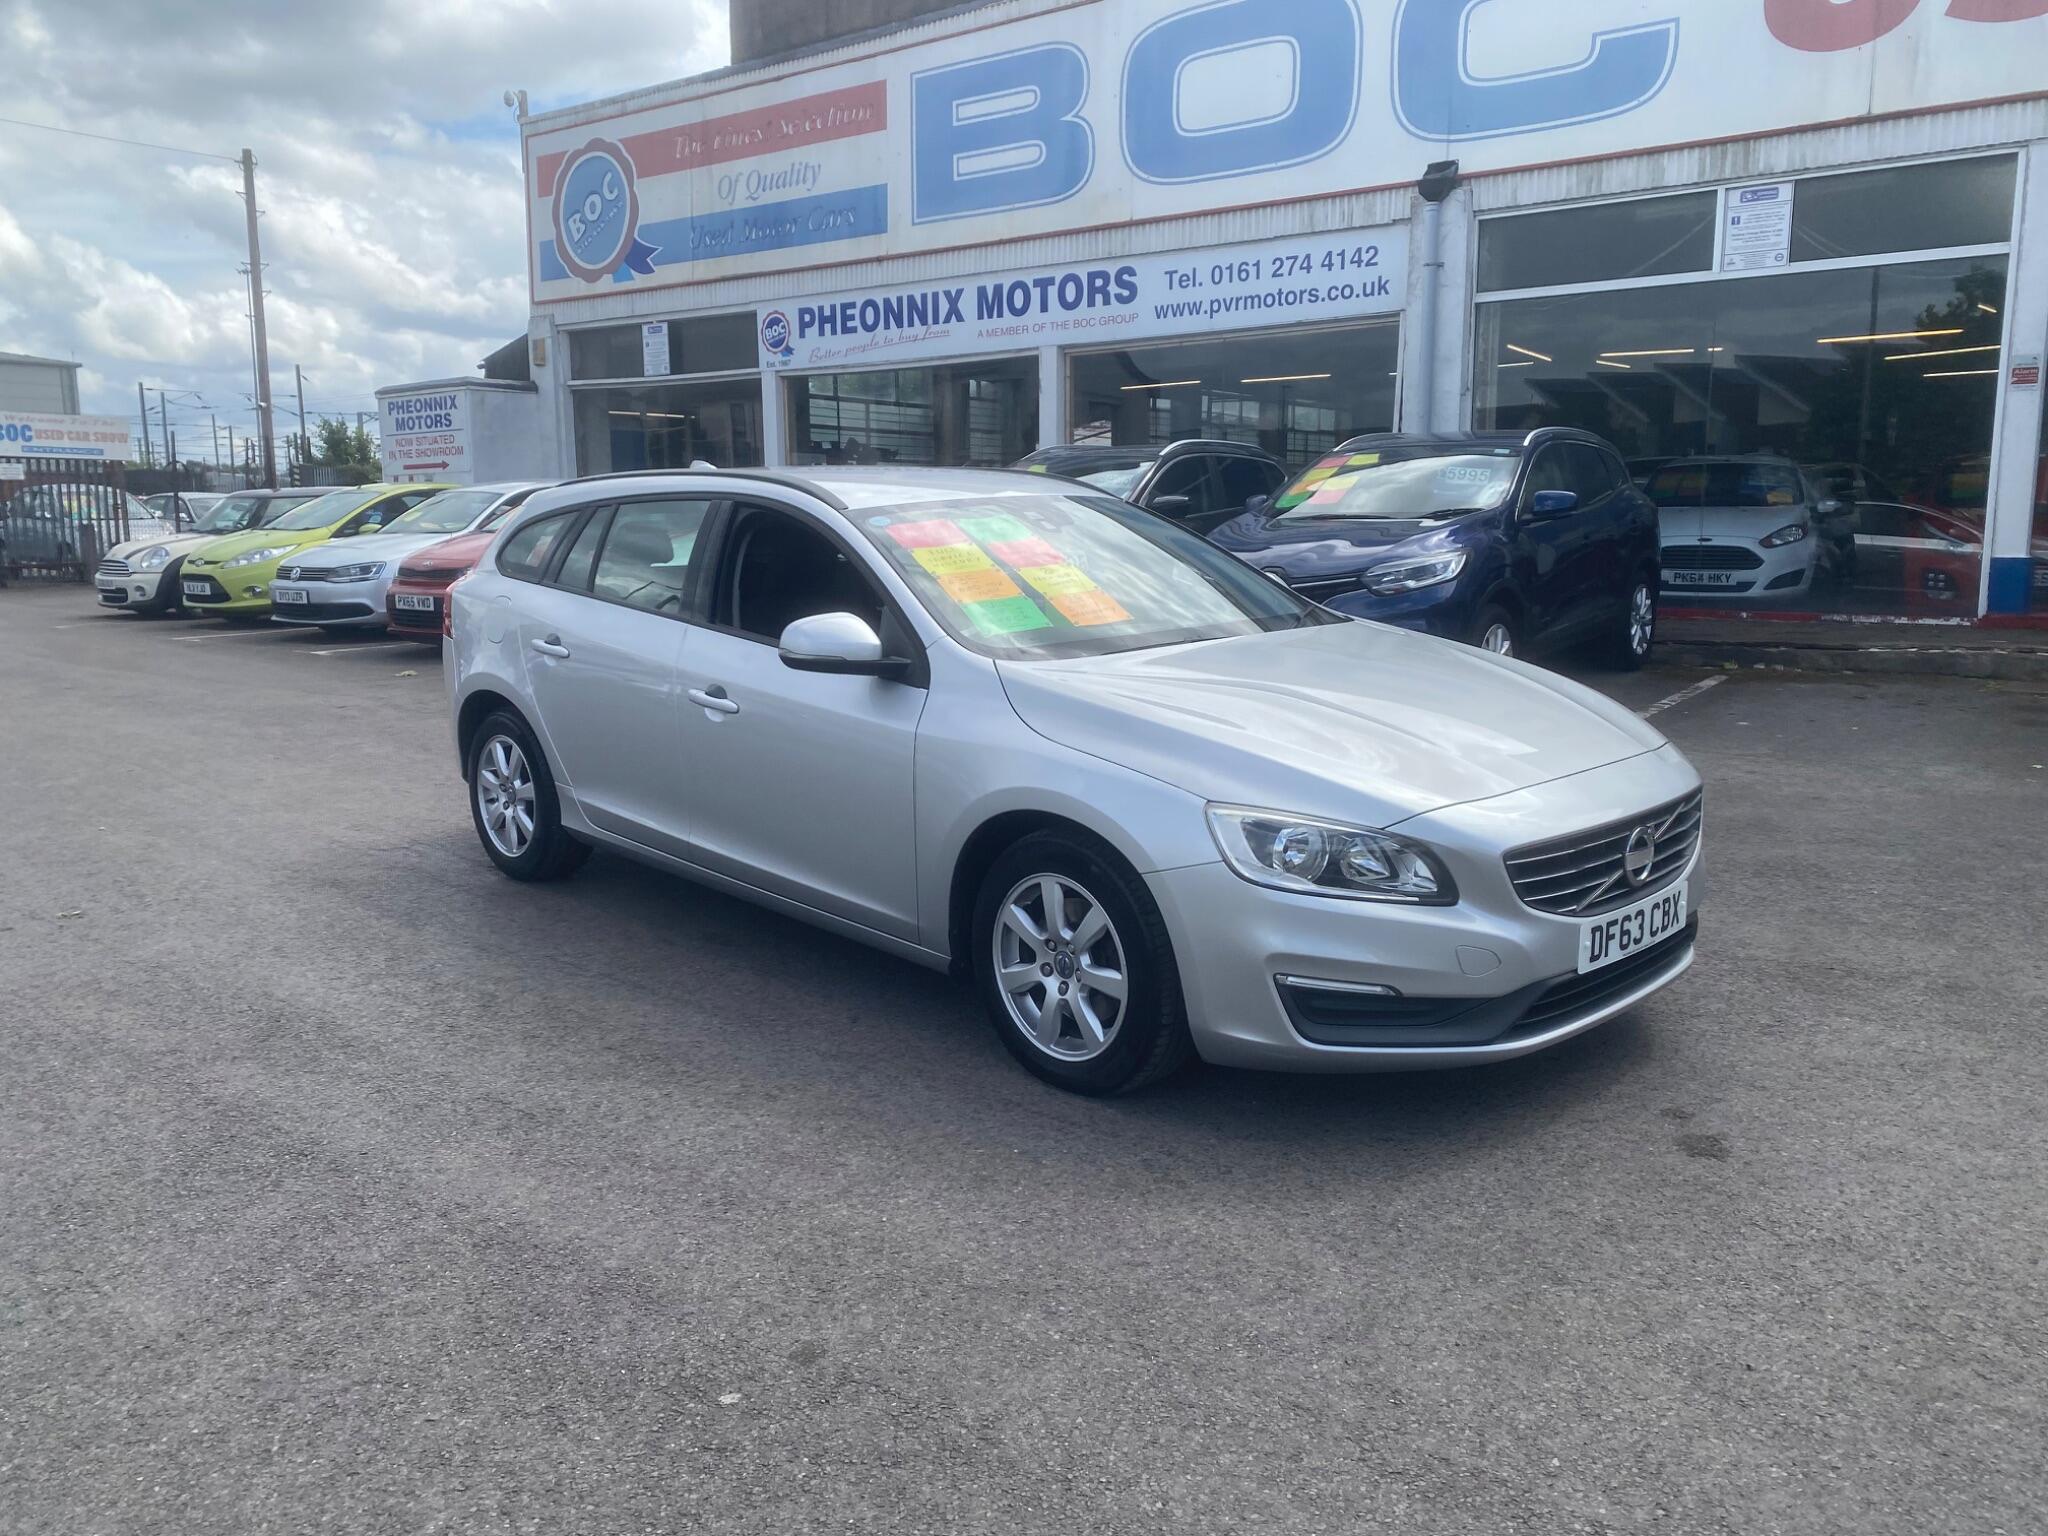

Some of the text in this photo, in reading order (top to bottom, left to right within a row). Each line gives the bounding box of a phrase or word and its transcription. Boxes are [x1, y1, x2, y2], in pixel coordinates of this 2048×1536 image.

[911, 0, 1680, 226] BOC
[718, 161, 822, 206] Of Quality
[567, 171, 619, 243] BOC
[689, 206, 857, 250] Used Motor Cars
[1165, 245, 1379, 290] Tel. 0161 274 4142
[798, 265, 1138, 339] PHEONNIX MOTORS
[1154, 275, 1390, 319] www.pvrmotors.co.uk
[766, 321, 786, 340] BOC
[809, 324, 950, 363] Better people to buy from
[977, 313, 1139, 339] A MEMBER OF THE BOC GROUP
[388, 395, 458, 416] PHEONNIX
[395, 413, 452, 432] MOTORS
[67, 431, 91, 442] CAR
[389, 446, 464, 460] IN THE SHOWROOM
[395, 434, 455, 448] NOW SITUATED
[1708, 573, 1732, 584] HKY
[1590, 890, 1681, 963] DF63 CBX
